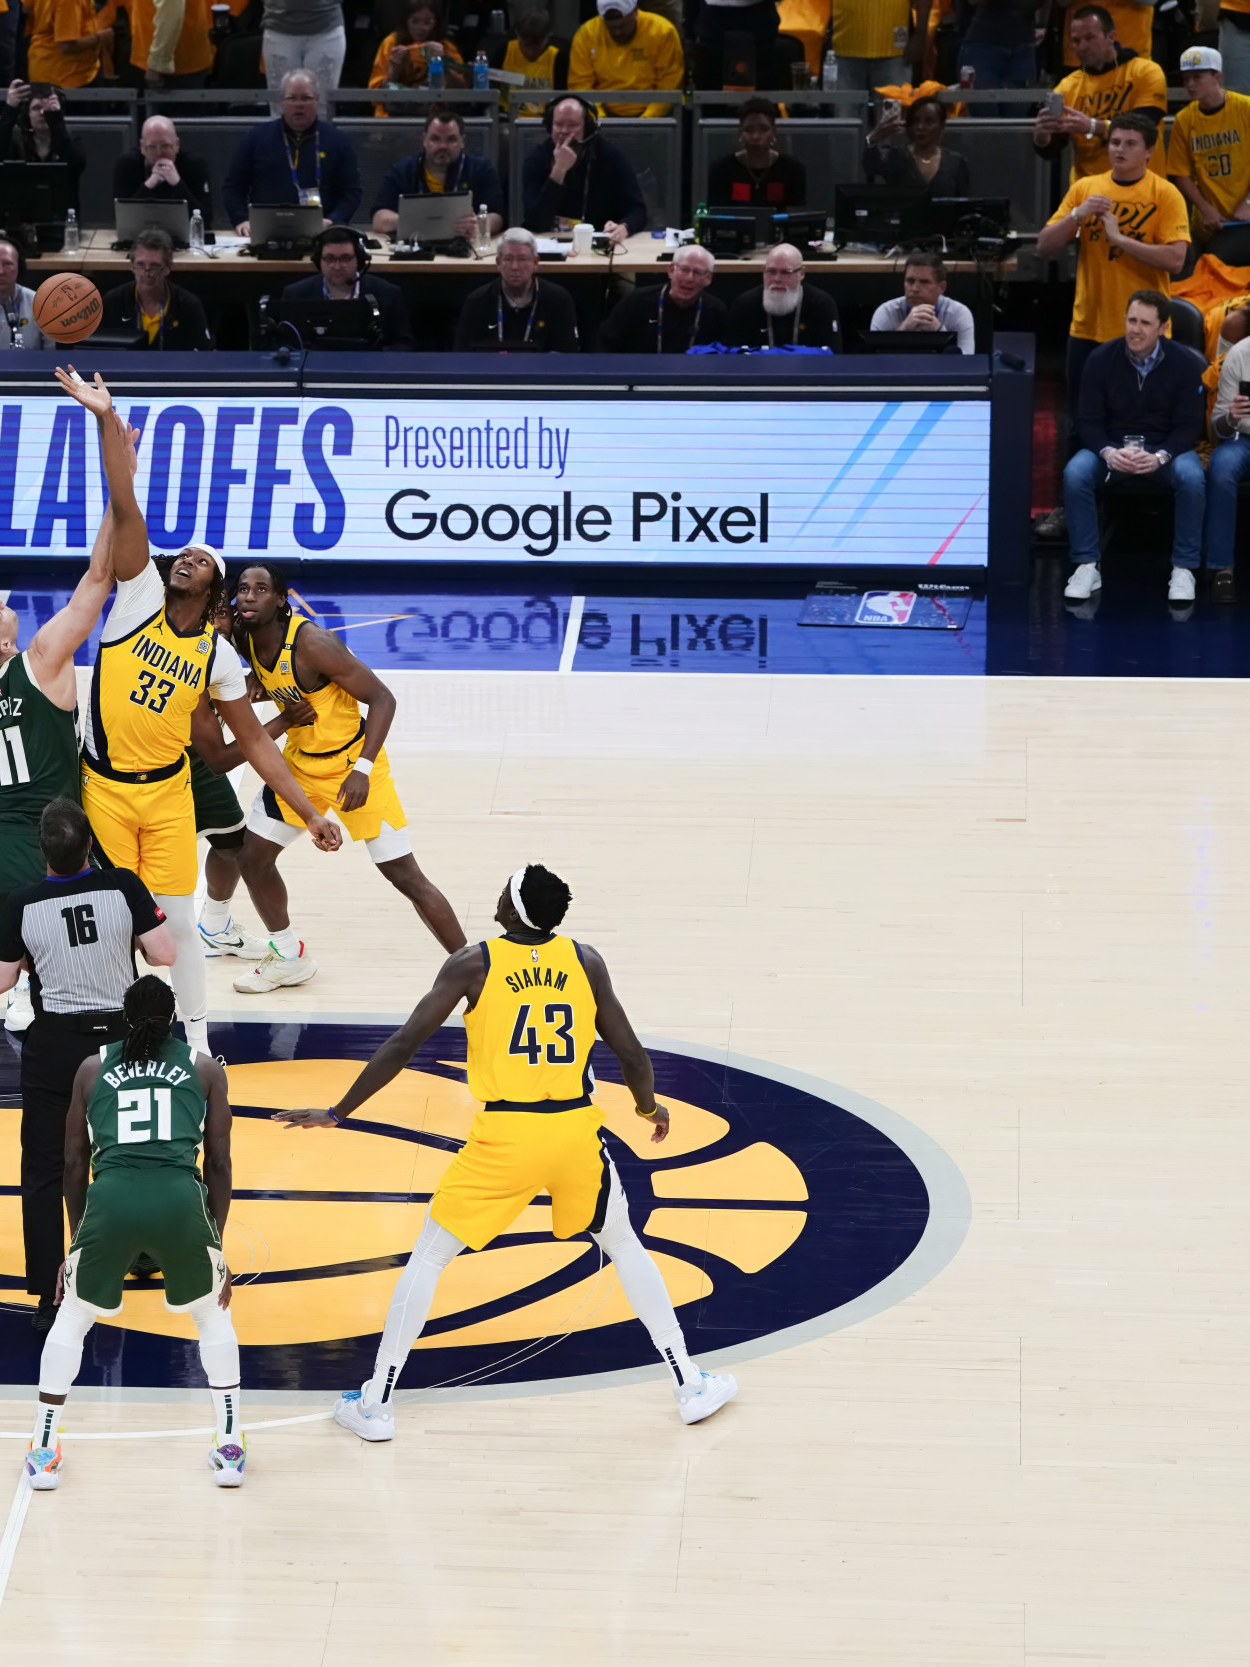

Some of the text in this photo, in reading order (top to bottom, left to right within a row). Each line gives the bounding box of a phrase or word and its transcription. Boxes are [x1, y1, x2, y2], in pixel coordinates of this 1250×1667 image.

[1191, 129, 1241, 153] INDIANA
[385, 416, 570, 478] Presented by
[385, 488, 769, 557] Google Pixel
[131, 634, 202, 690] INDIANA
[129, 669, 176, 715] 33
[60, 903, 99, 948] 16
[505, 967, 569, 994] SIAKAM
[508, 1003, 576, 1066] 43
[102, 1059, 192, 1089] BEVERLEY
[117, 1087, 172, 1145] 21
